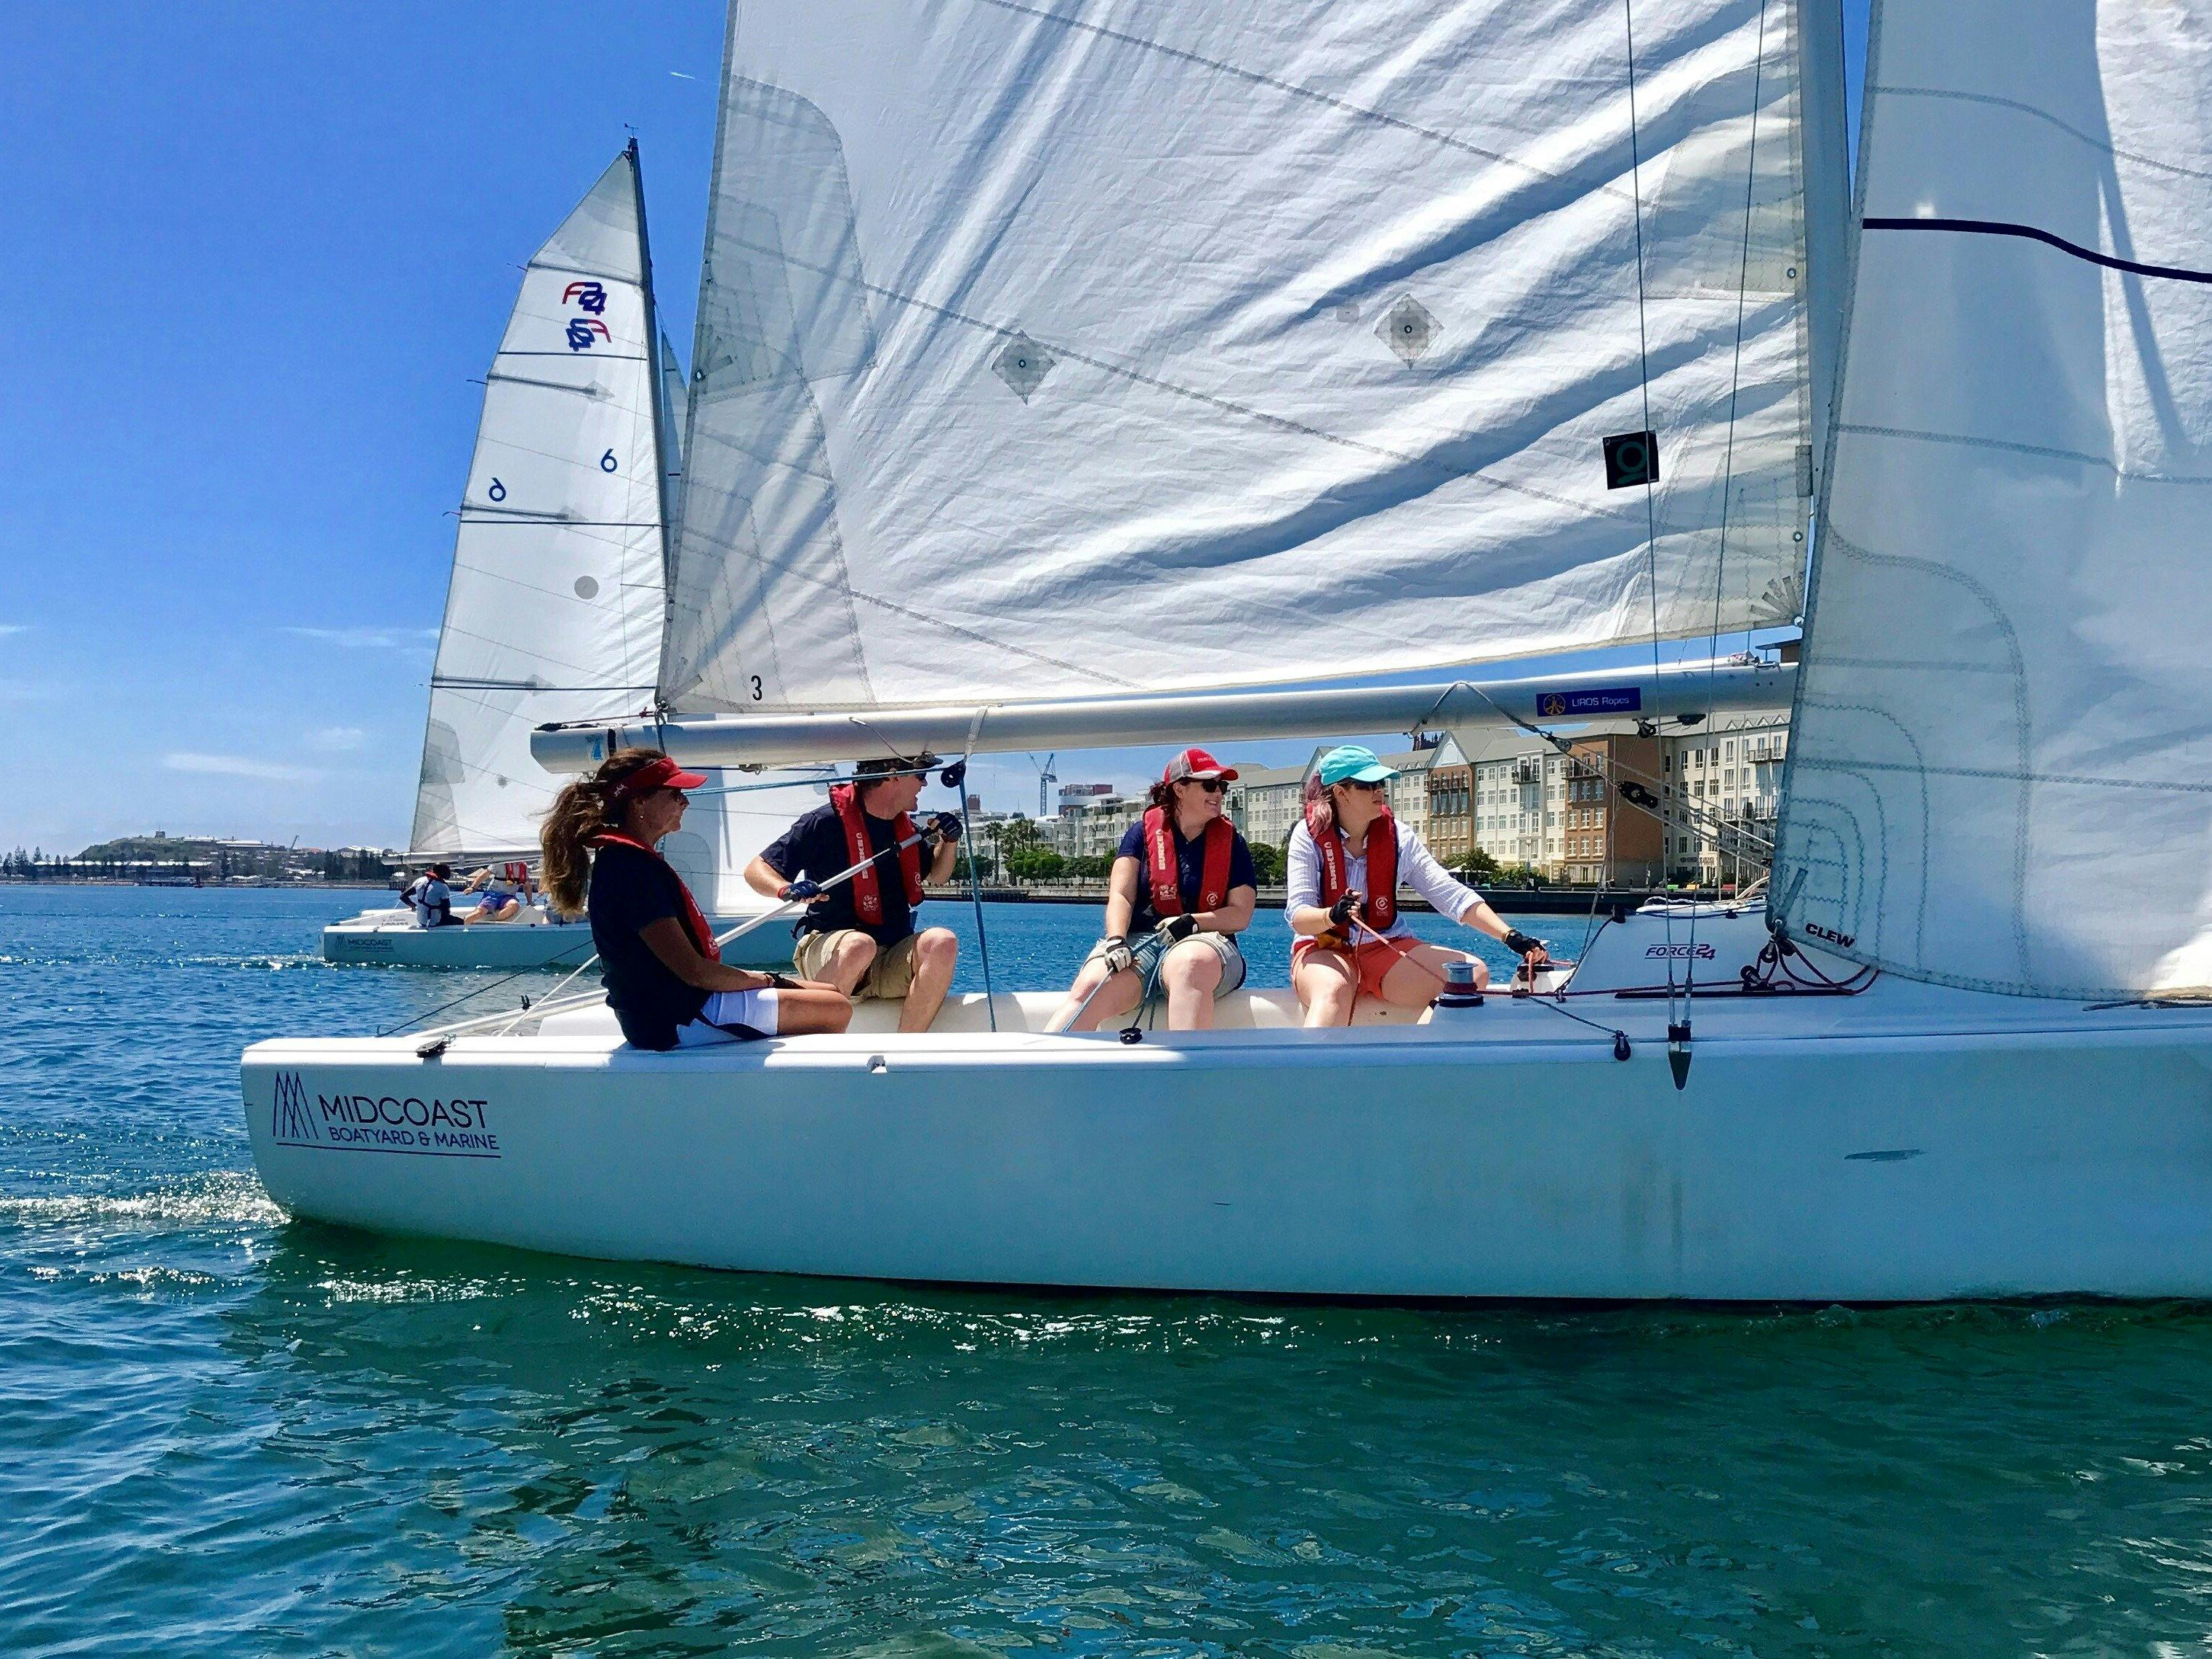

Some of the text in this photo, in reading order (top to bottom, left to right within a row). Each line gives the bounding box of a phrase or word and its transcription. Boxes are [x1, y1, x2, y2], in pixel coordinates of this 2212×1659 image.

[600, 448, 618, 473] 6
[751, 675, 763, 701] 3
[1601, 696, 1630, 707] Ropes
[1805, 923, 1856, 948] CLEW
[318, 1093, 488, 1130] MIDCOAST
[329, 1125, 501, 1151] BOATYARD & MARINE
